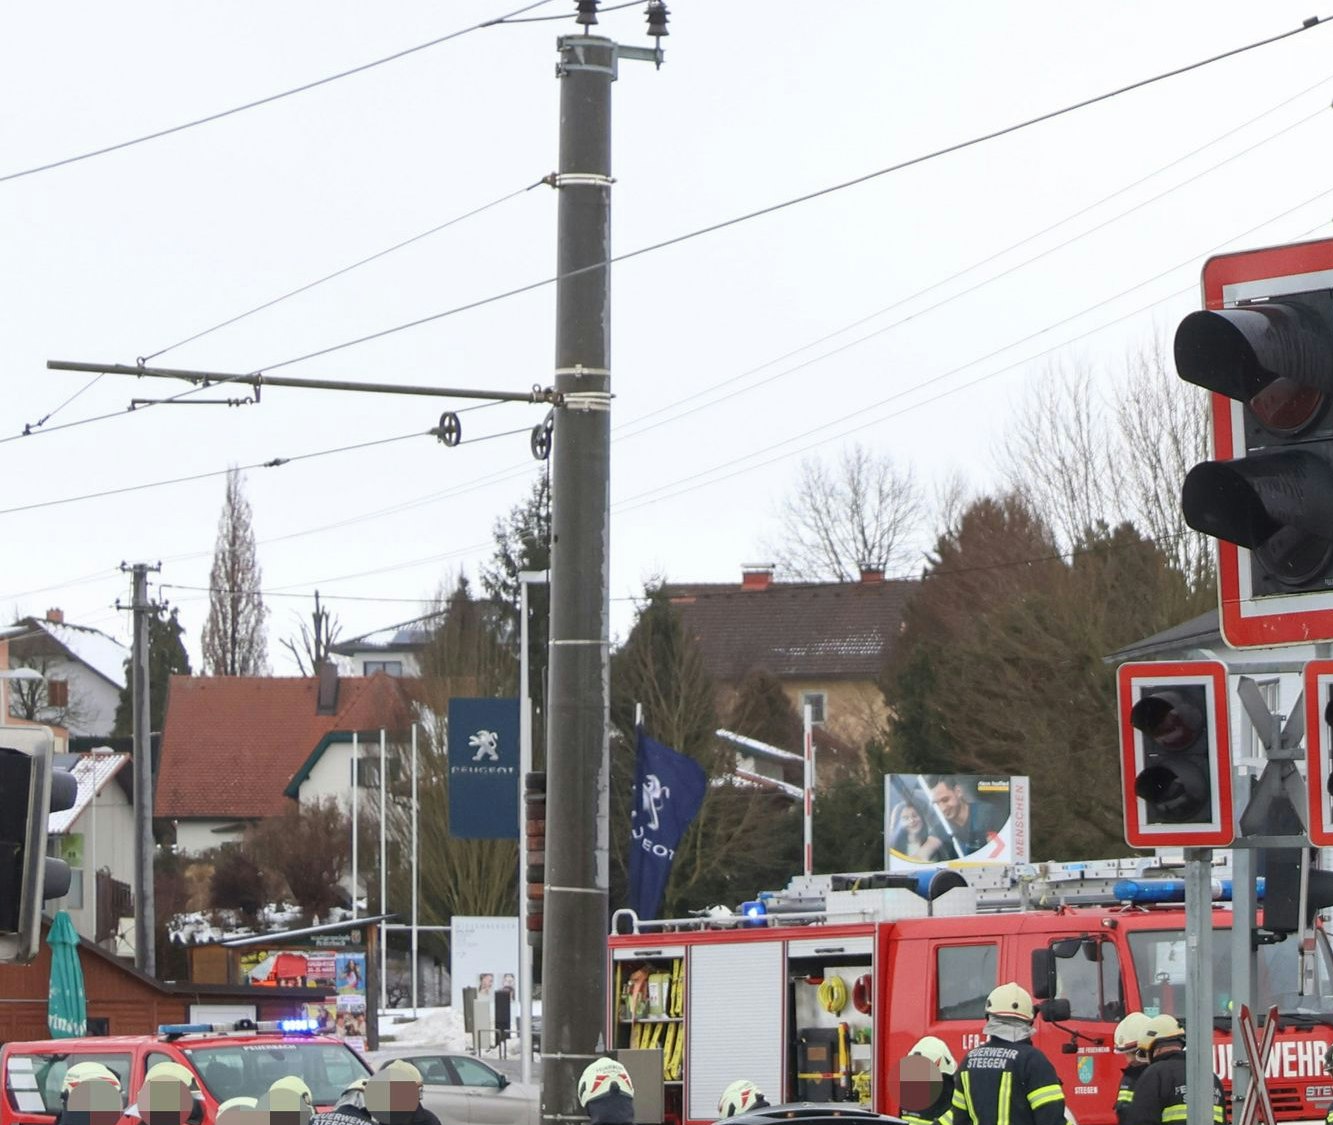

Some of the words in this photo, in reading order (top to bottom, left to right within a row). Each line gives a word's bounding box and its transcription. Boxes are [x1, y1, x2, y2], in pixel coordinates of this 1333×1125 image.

[451, 766, 514, 775] PEUGEOT
[1015, 784, 1025, 857] MENSCHEN
[243, 1043, 296, 1051] PEUERBACH
[962, 1034, 991, 1050] LFB-
[968, 1047, 1019, 1060] EUERWEHR
[967, 1058, 1007, 1069] STEEGEN
